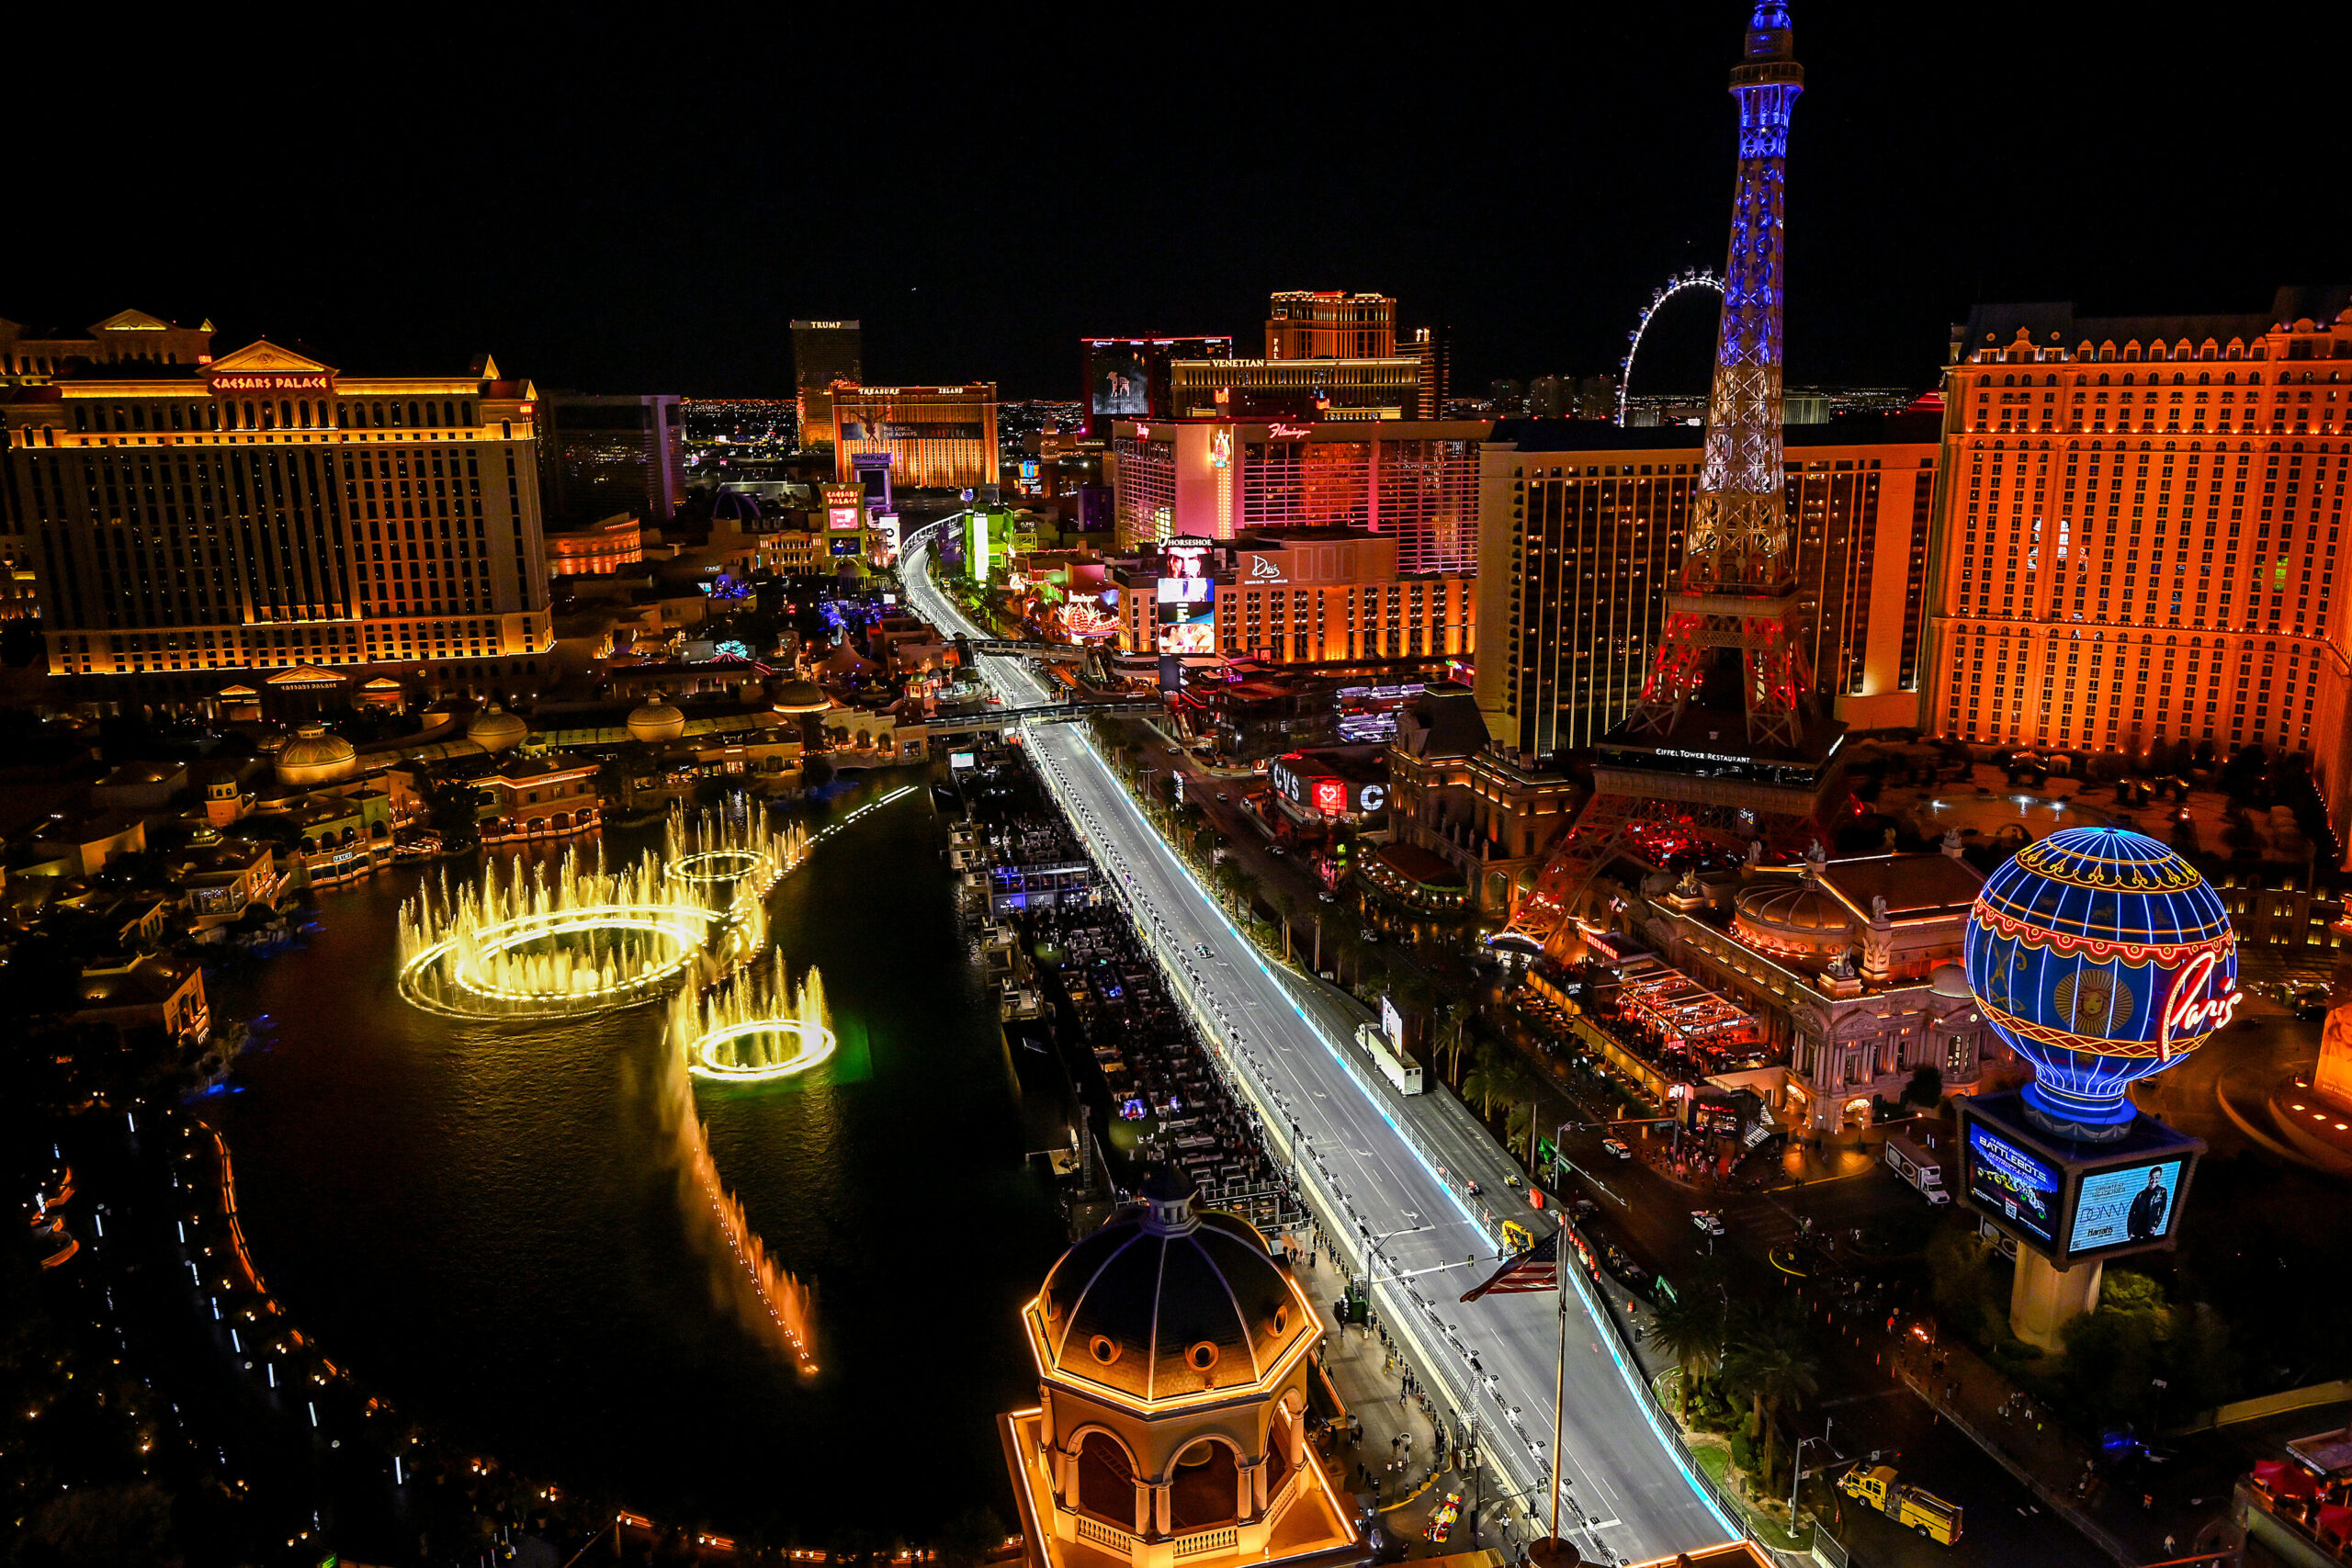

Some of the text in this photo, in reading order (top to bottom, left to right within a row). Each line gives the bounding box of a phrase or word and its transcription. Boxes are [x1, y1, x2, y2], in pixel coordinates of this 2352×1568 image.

[1213, 359, 1264, 367] VENETIAN
[212, 378, 327, 389] CAESARS PALACE
[1269, 423, 1311, 439] Flamingo
[1168, 538, 1212, 547] HORSESHOE
[1656, 748, 1750, 763] EIFFEL TOWER RESTAURANT
[1274, 762, 1300, 802] CVS
[1587, 933, 1618, 961] BEER PARK
[2162, 951, 2243, 1063] Paris
[1979, 1135, 2047, 1183] BATTLEBOTS
[2079, 1200, 2132, 1224] DONNY
